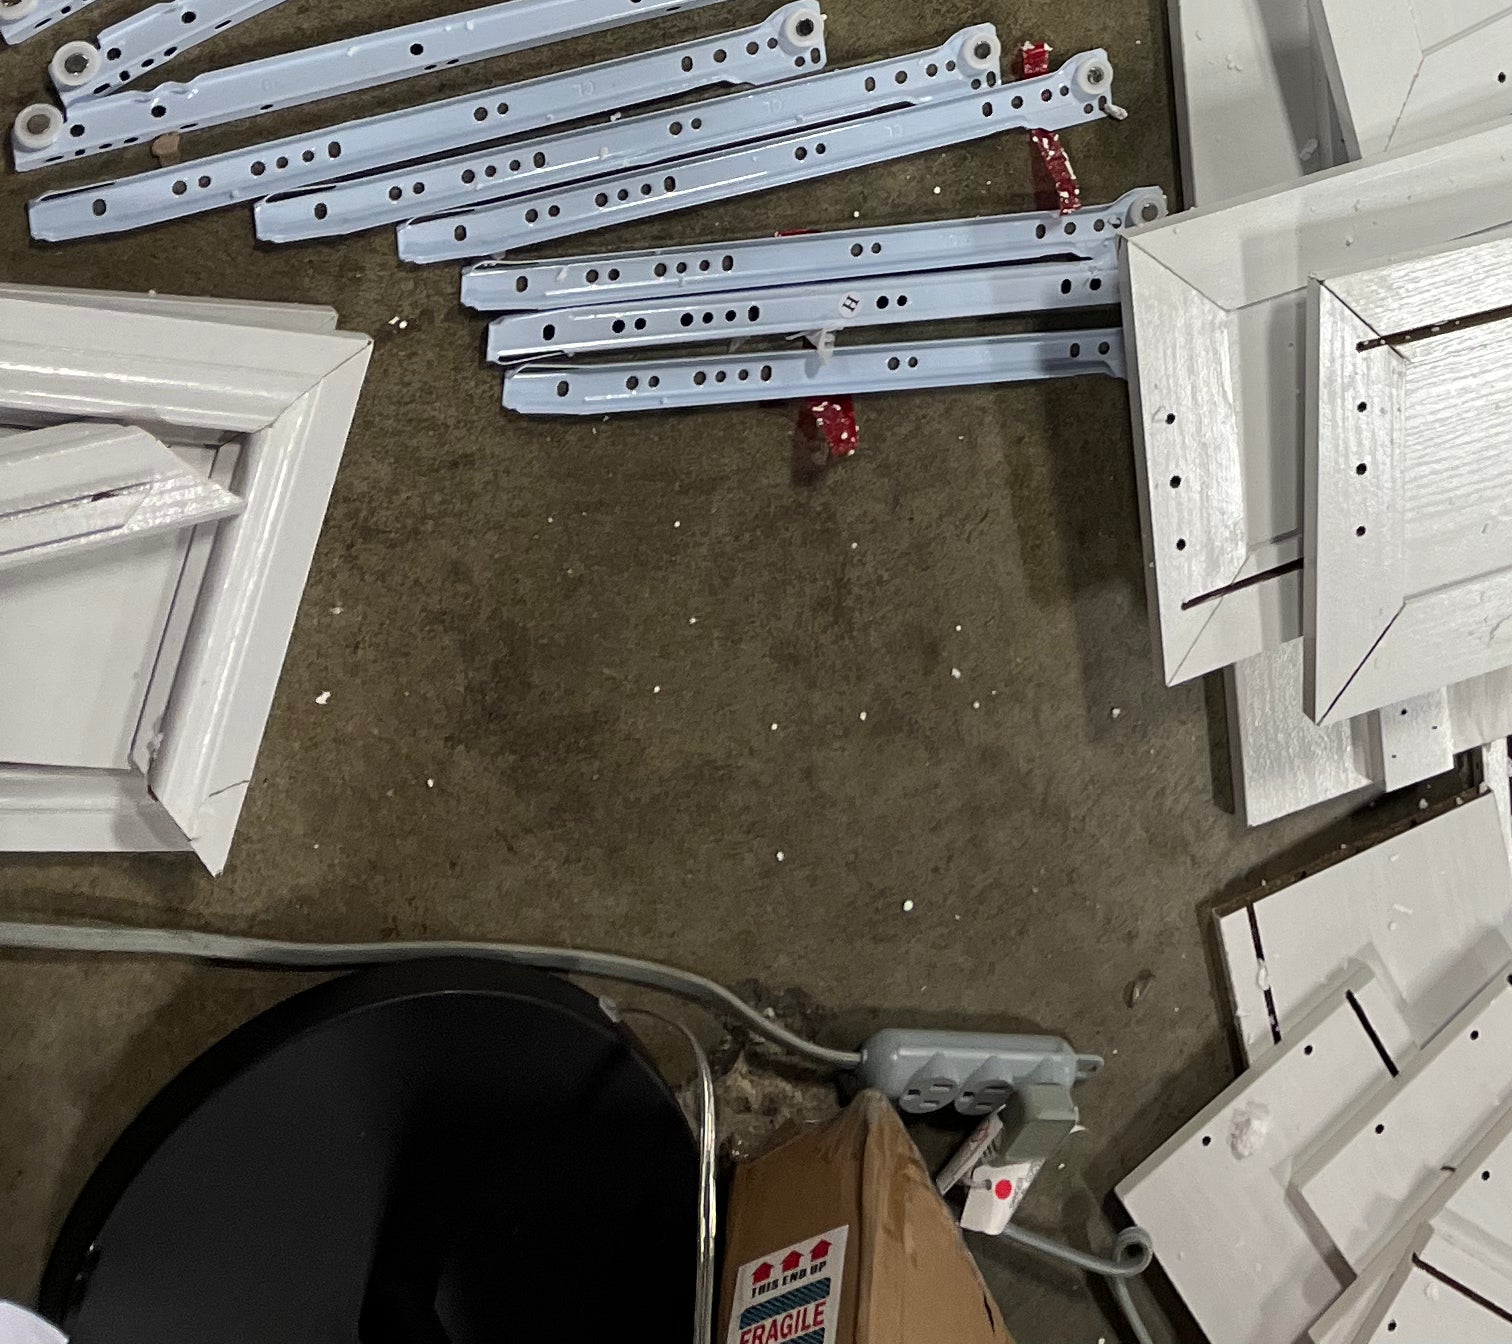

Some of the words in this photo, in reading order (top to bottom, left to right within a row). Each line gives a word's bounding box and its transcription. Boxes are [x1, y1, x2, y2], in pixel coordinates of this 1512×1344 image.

[842, 296, 860, 311] H
[751, 1278, 780, 1299] THIS
[782, 1268, 807, 1287] END
[810, 1260, 827, 1275] UP
[738, 1298, 828, 1344] FRAGILE
